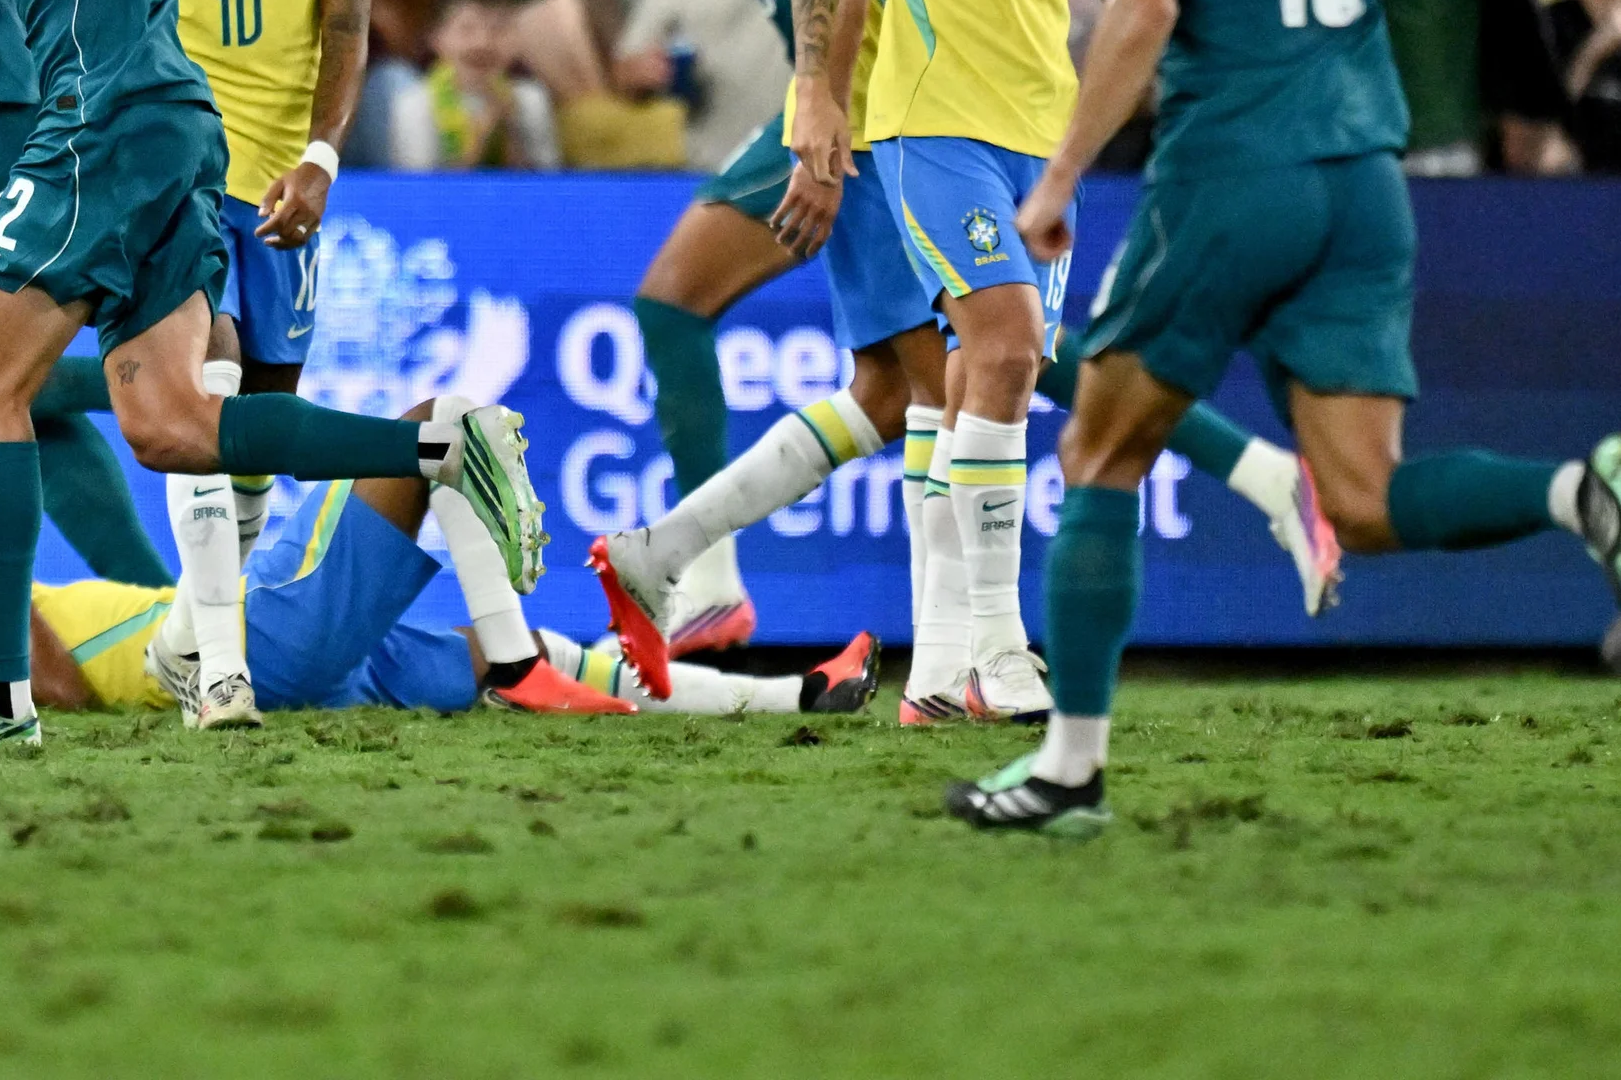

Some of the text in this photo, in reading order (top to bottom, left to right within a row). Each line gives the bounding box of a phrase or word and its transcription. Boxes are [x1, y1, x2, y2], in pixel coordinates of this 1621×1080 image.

[1045, 250, 1073, 311] 19
[193, 506, 230, 521] BRASIL
[981, 519, 1017, 532] BRASIL
